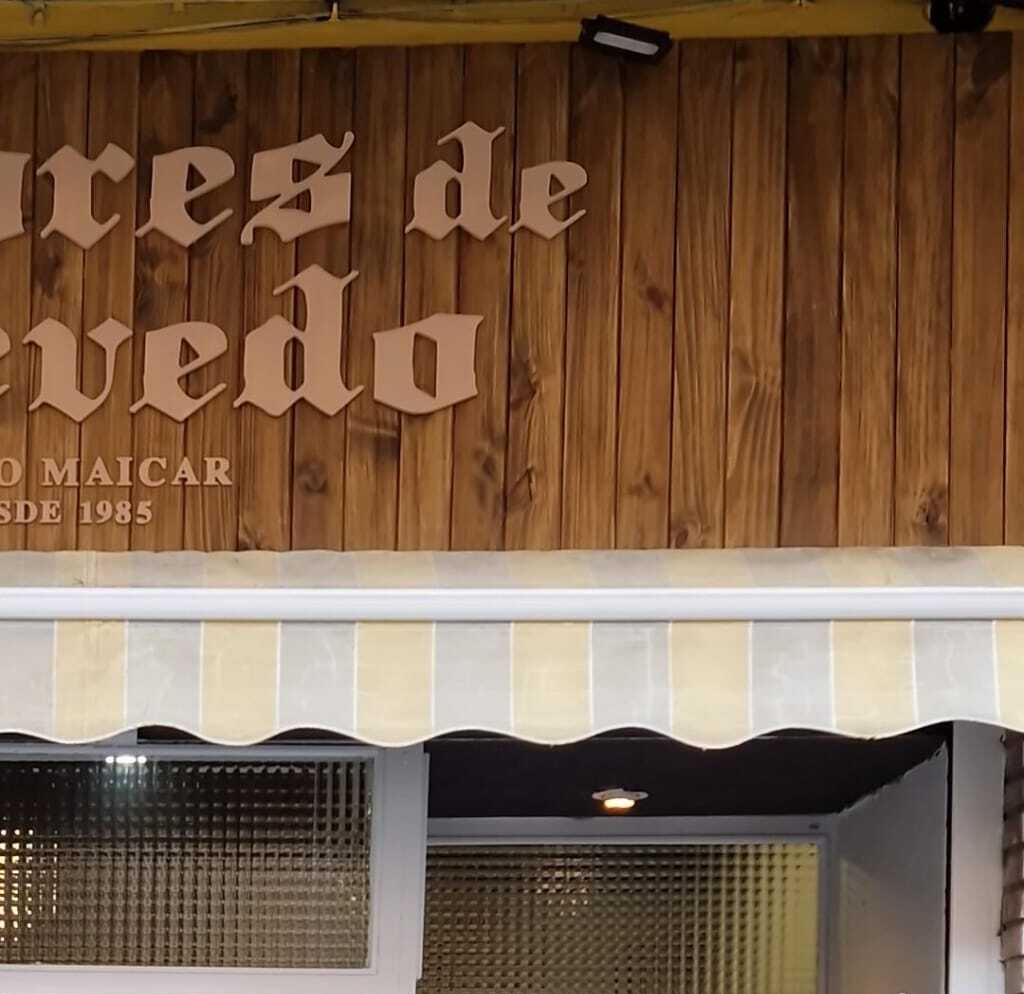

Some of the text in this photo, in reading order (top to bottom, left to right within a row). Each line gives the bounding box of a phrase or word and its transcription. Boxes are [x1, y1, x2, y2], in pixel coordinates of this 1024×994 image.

[405, 120, 588, 240] de
[40, 457, 233, 487] MAICAR
[79, 500, 153, 525] 1985
